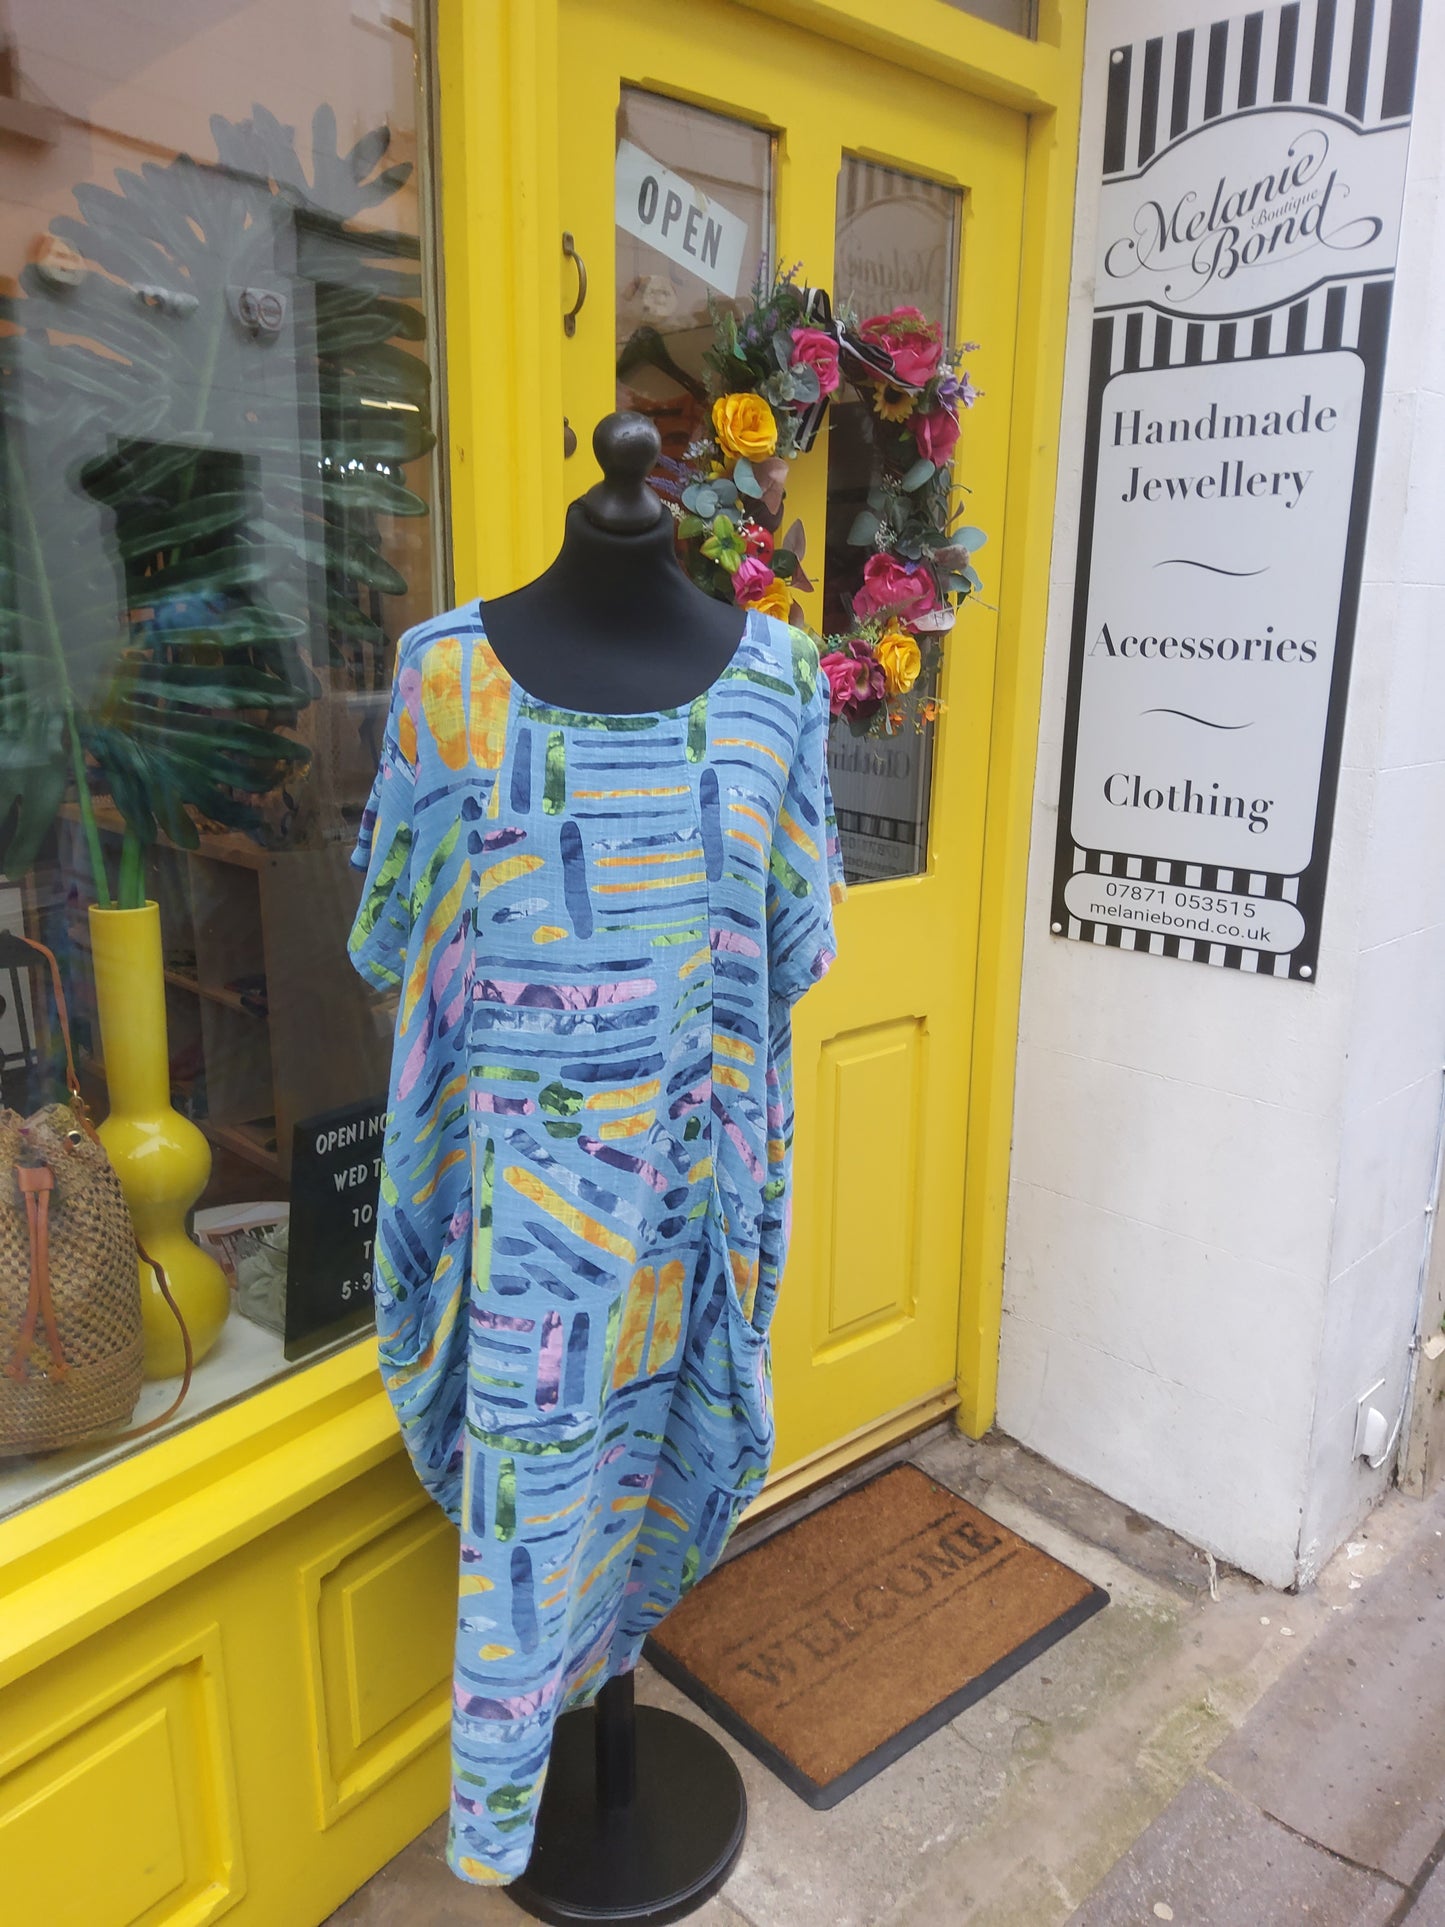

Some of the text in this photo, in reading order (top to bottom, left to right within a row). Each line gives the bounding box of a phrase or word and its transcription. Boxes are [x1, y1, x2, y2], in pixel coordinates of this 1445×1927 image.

[637, 175, 723, 270] OPEN
[1105, 129, 1329, 278] Melanie
[1250, 188, 1319, 230] Boutique
[1165, 169, 1383, 302] Bond
[1110, 394, 1338, 448] Handmade
[1121, 460, 1314, 509] Jewellery
[1087, 622, 1318, 664] Accessories
[1103, 772, 1274, 834] Clothing
[1089, 900, 1272, 944] melaniebond.co.uk
[1106, 881, 1257, 919] 07871 053515
[333, 1164, 367, 1192] WED
[352, 1204, 373, 1228] 10
[341, 1272, 374, 1300] 5:3
[736, 1520, 1002, 1689] WELCOME
